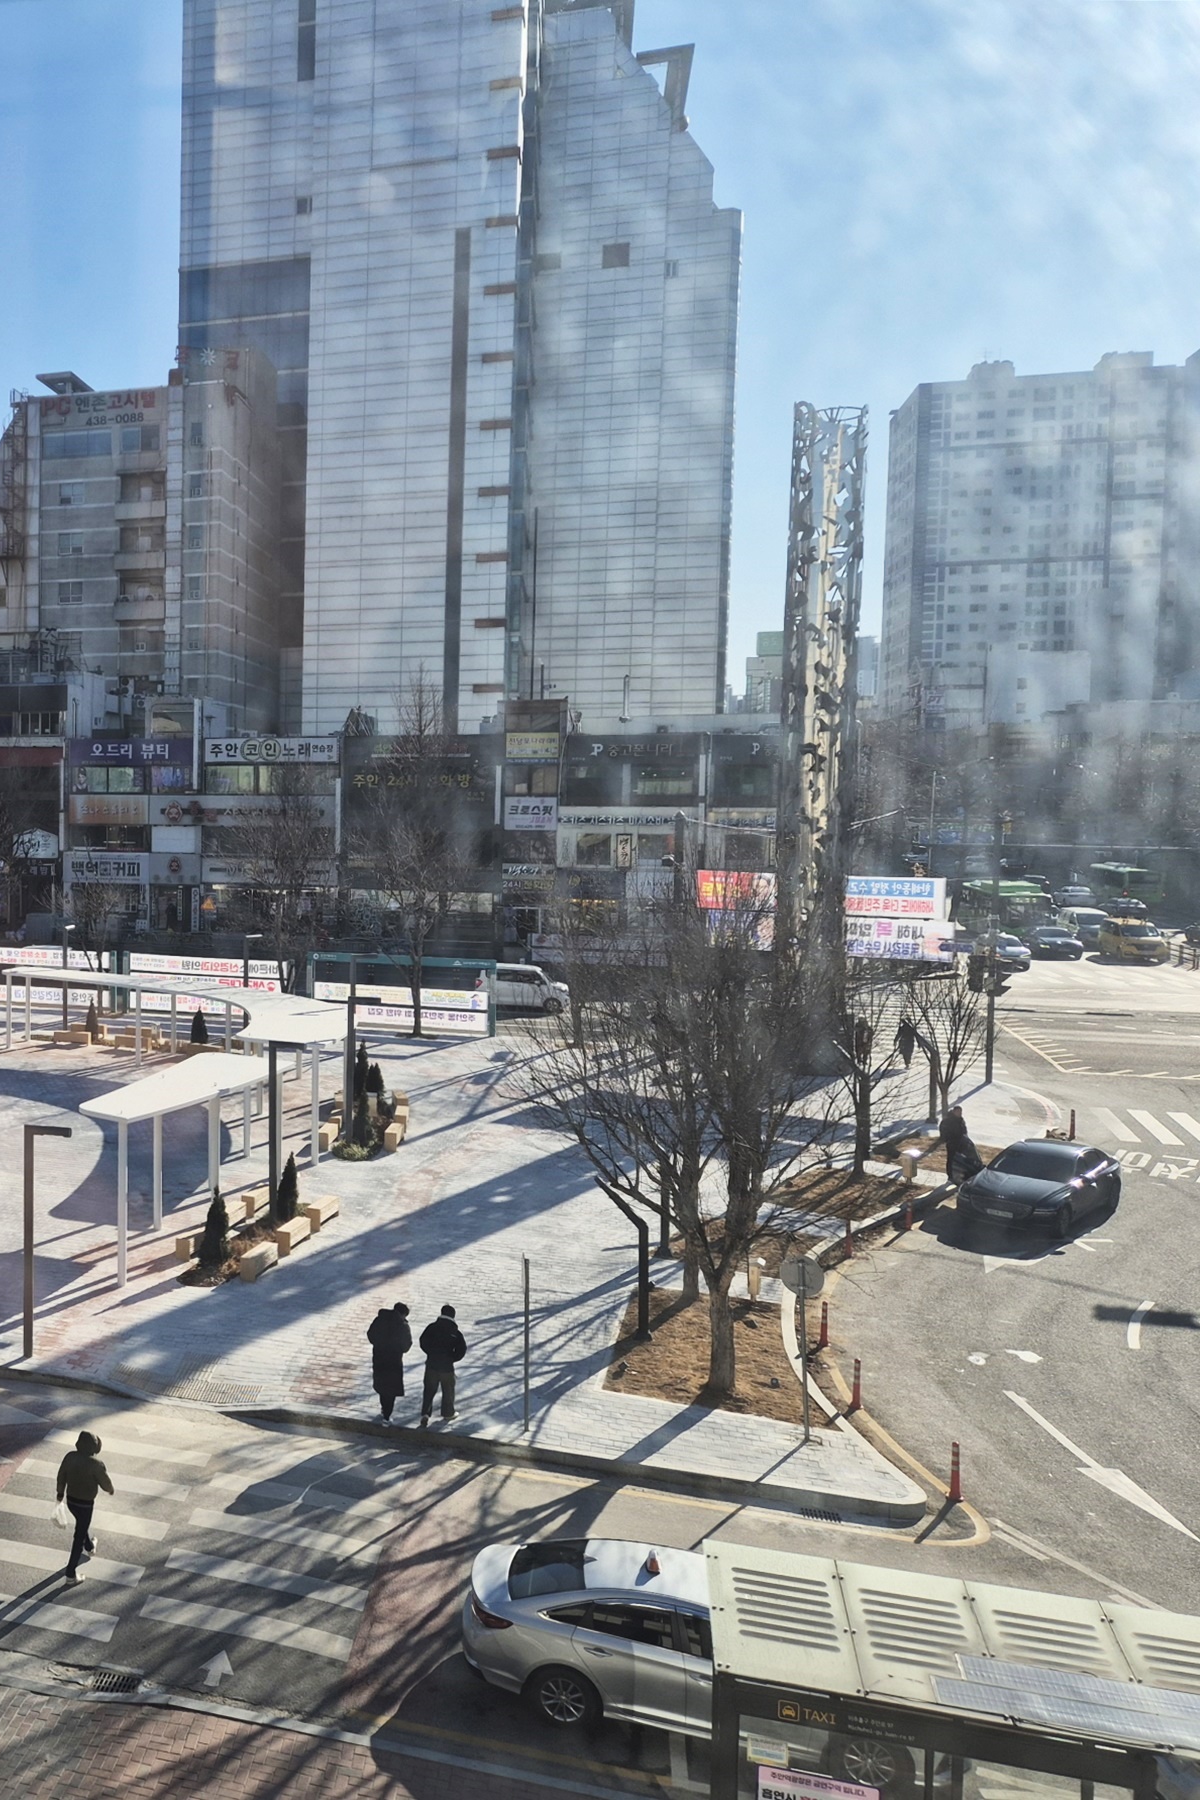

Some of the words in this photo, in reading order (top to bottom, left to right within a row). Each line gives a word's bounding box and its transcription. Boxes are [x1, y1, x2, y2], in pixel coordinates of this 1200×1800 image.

[41, 397, 71, 417] PC
[86, 412, 144, 426] 438-0088
[90, 743, 132, 759] 오드리
[140, 743, 169, 759] 뷰티
[608, 743, 673, 757] 중고폰나라
[353, 774, 379, 788] 주안
[508, 805, 553, 816] 크로스핏
[803, 1707, 837, 1726] TAXI
[770, 1771, 812, 1787] 주안역광장은
